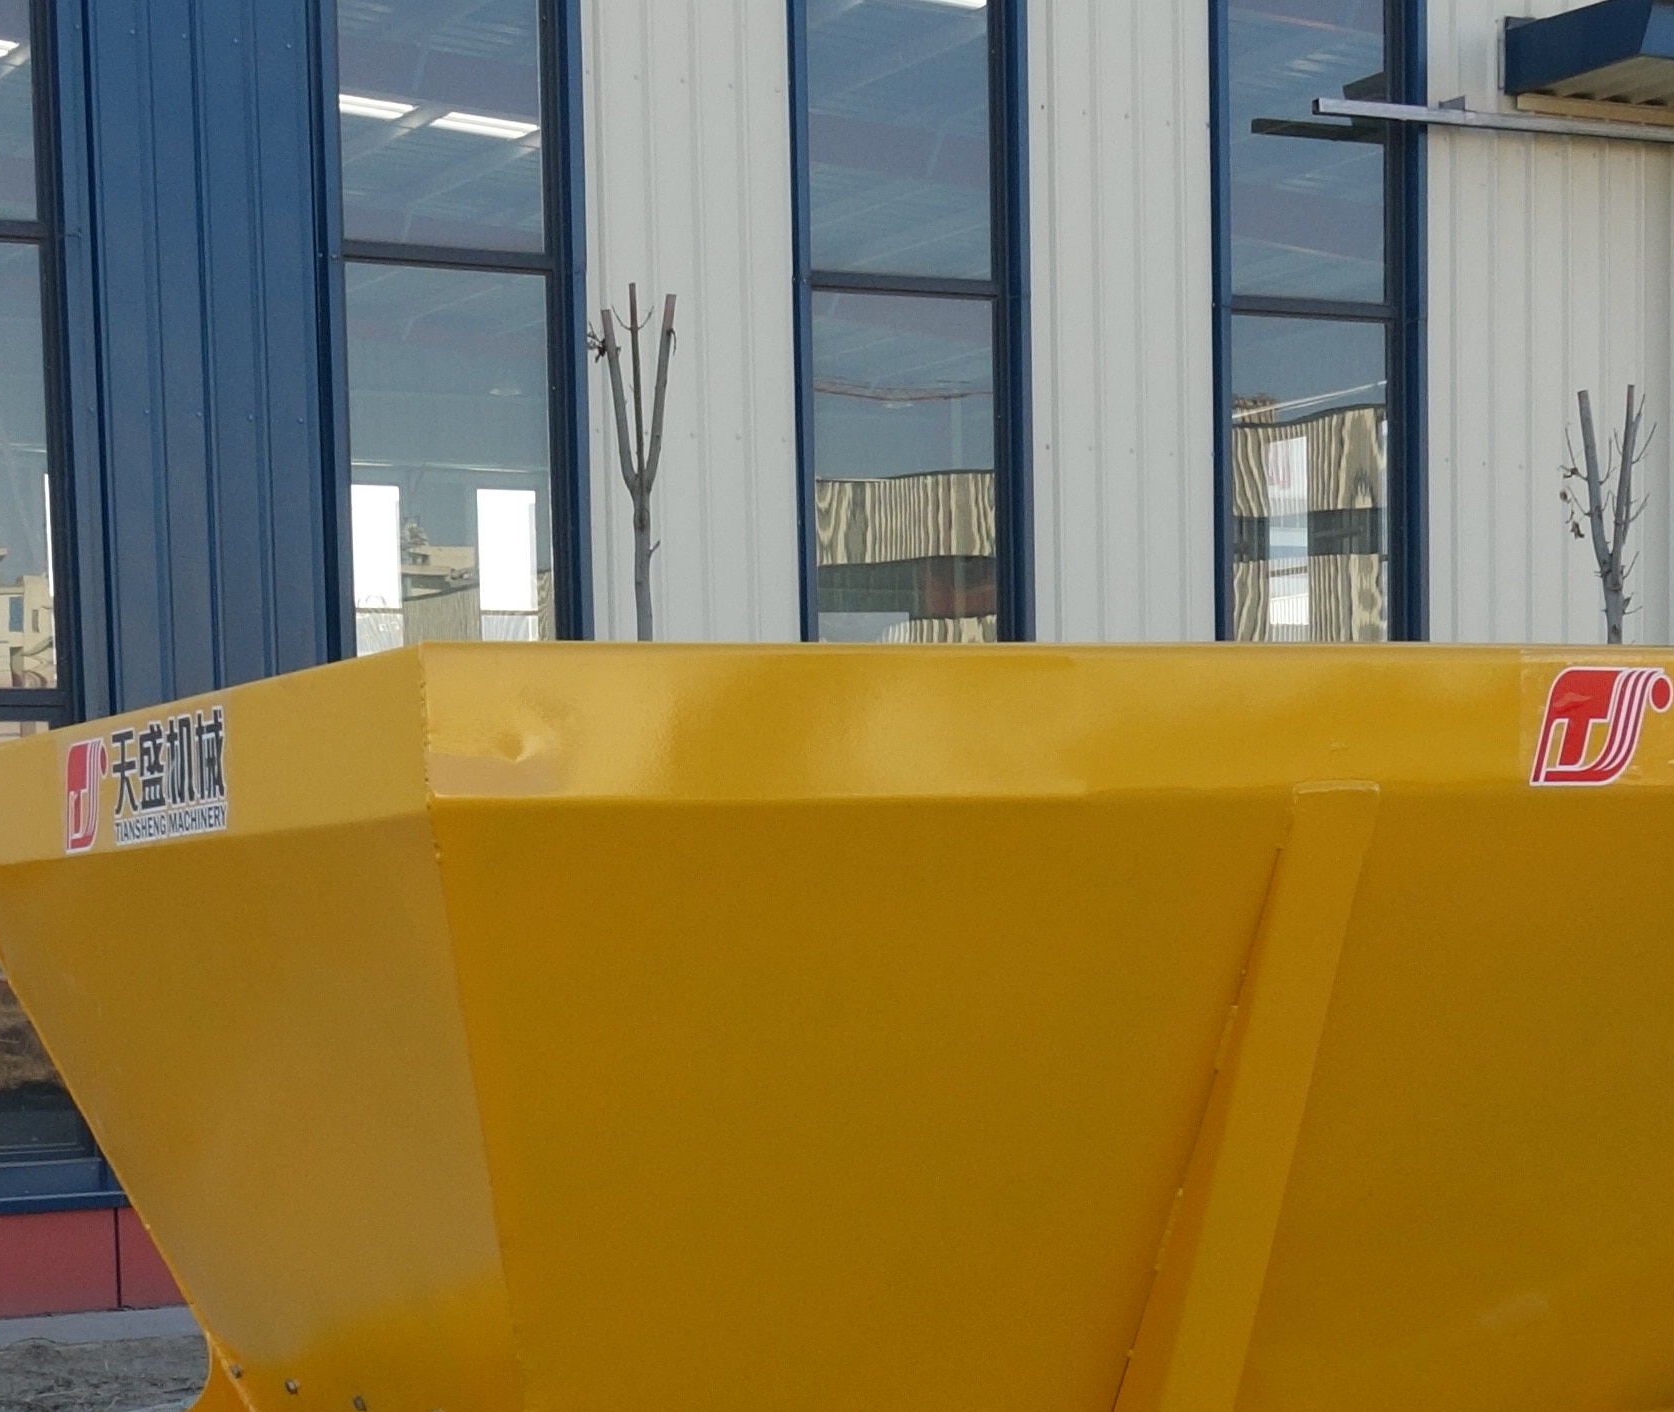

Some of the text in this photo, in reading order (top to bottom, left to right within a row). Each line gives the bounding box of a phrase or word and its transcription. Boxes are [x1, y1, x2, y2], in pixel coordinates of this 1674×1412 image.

[111, 708, 226, 815] 天盛机械
[115, 805, 227, 842] TIANSHENG MACHINERY
